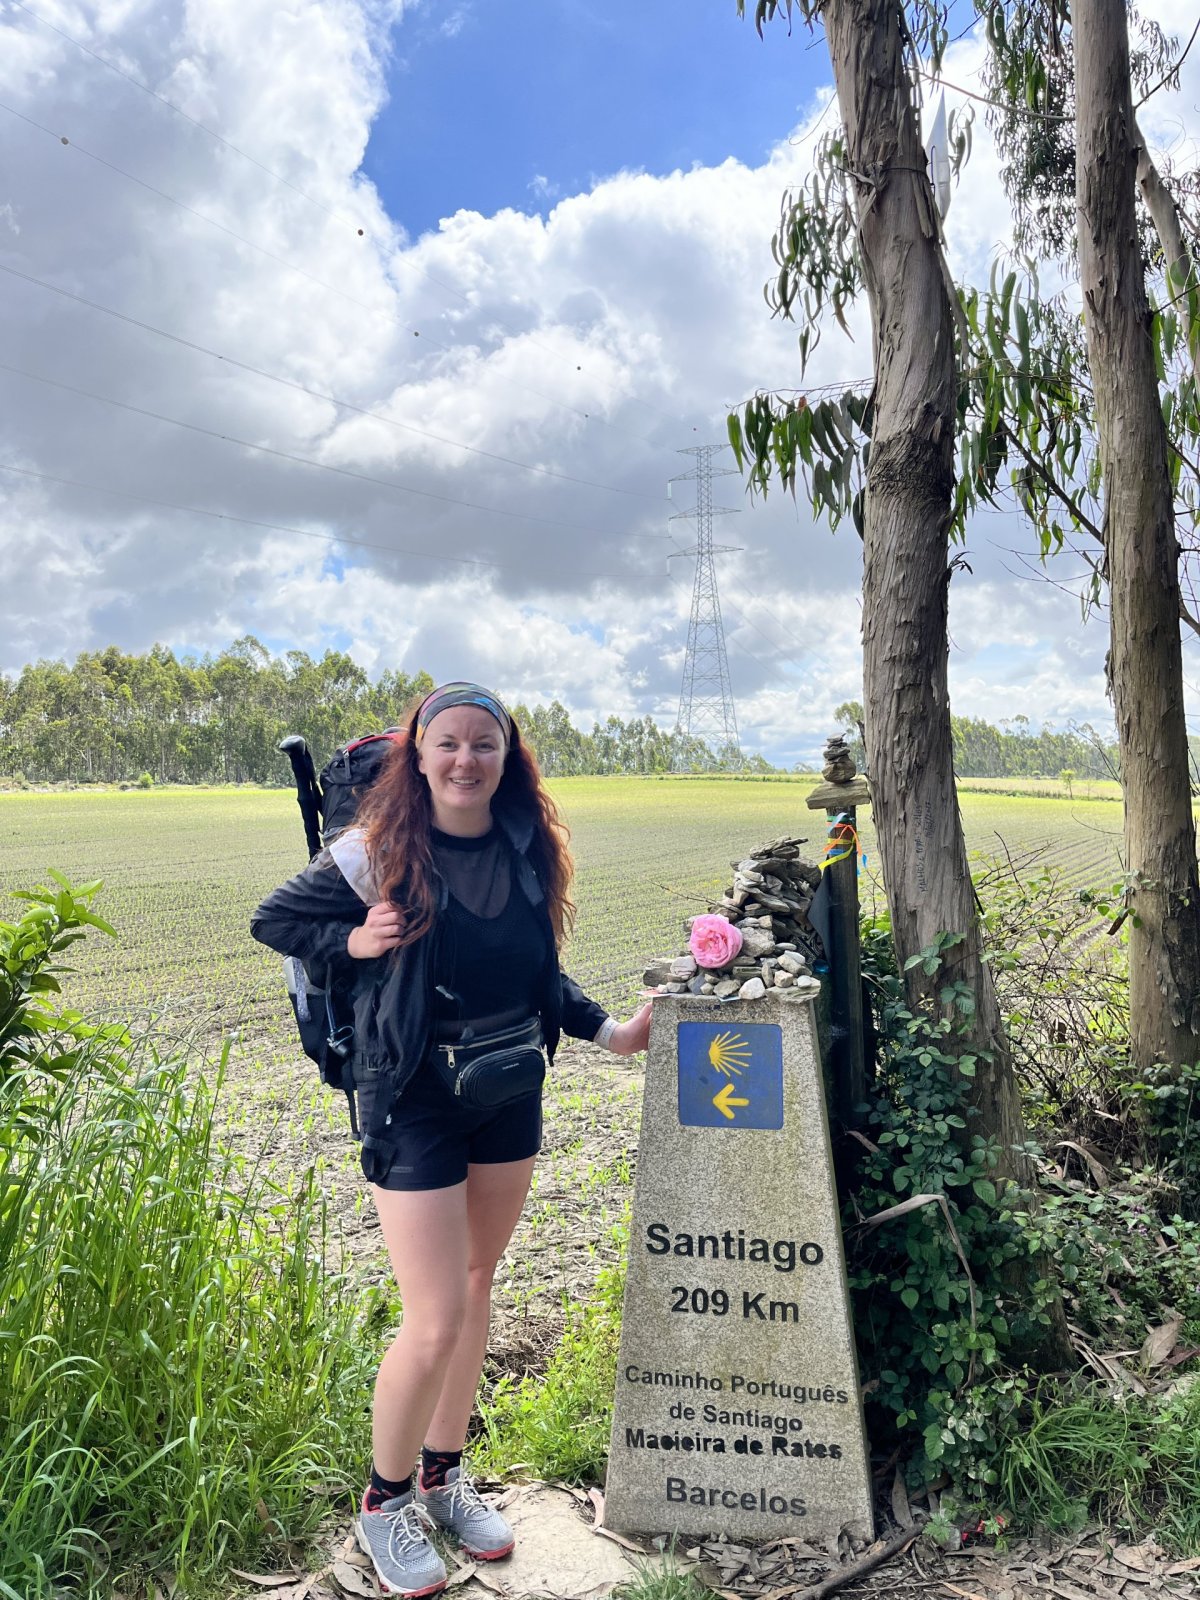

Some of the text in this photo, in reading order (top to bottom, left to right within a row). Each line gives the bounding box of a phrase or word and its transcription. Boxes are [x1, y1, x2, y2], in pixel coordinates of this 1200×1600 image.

[646, 1223, 824, 1272] Santiago
[671, 1286, 799, 1323] 209 Km
[625, 1365, 849, 1404] Caminho Português
[669, 1402, 803, 1434] de Santiago
[625, 1428, 843, 1459] Macieira de Rates
[666, 1477, 807, 1517] Barcelos
